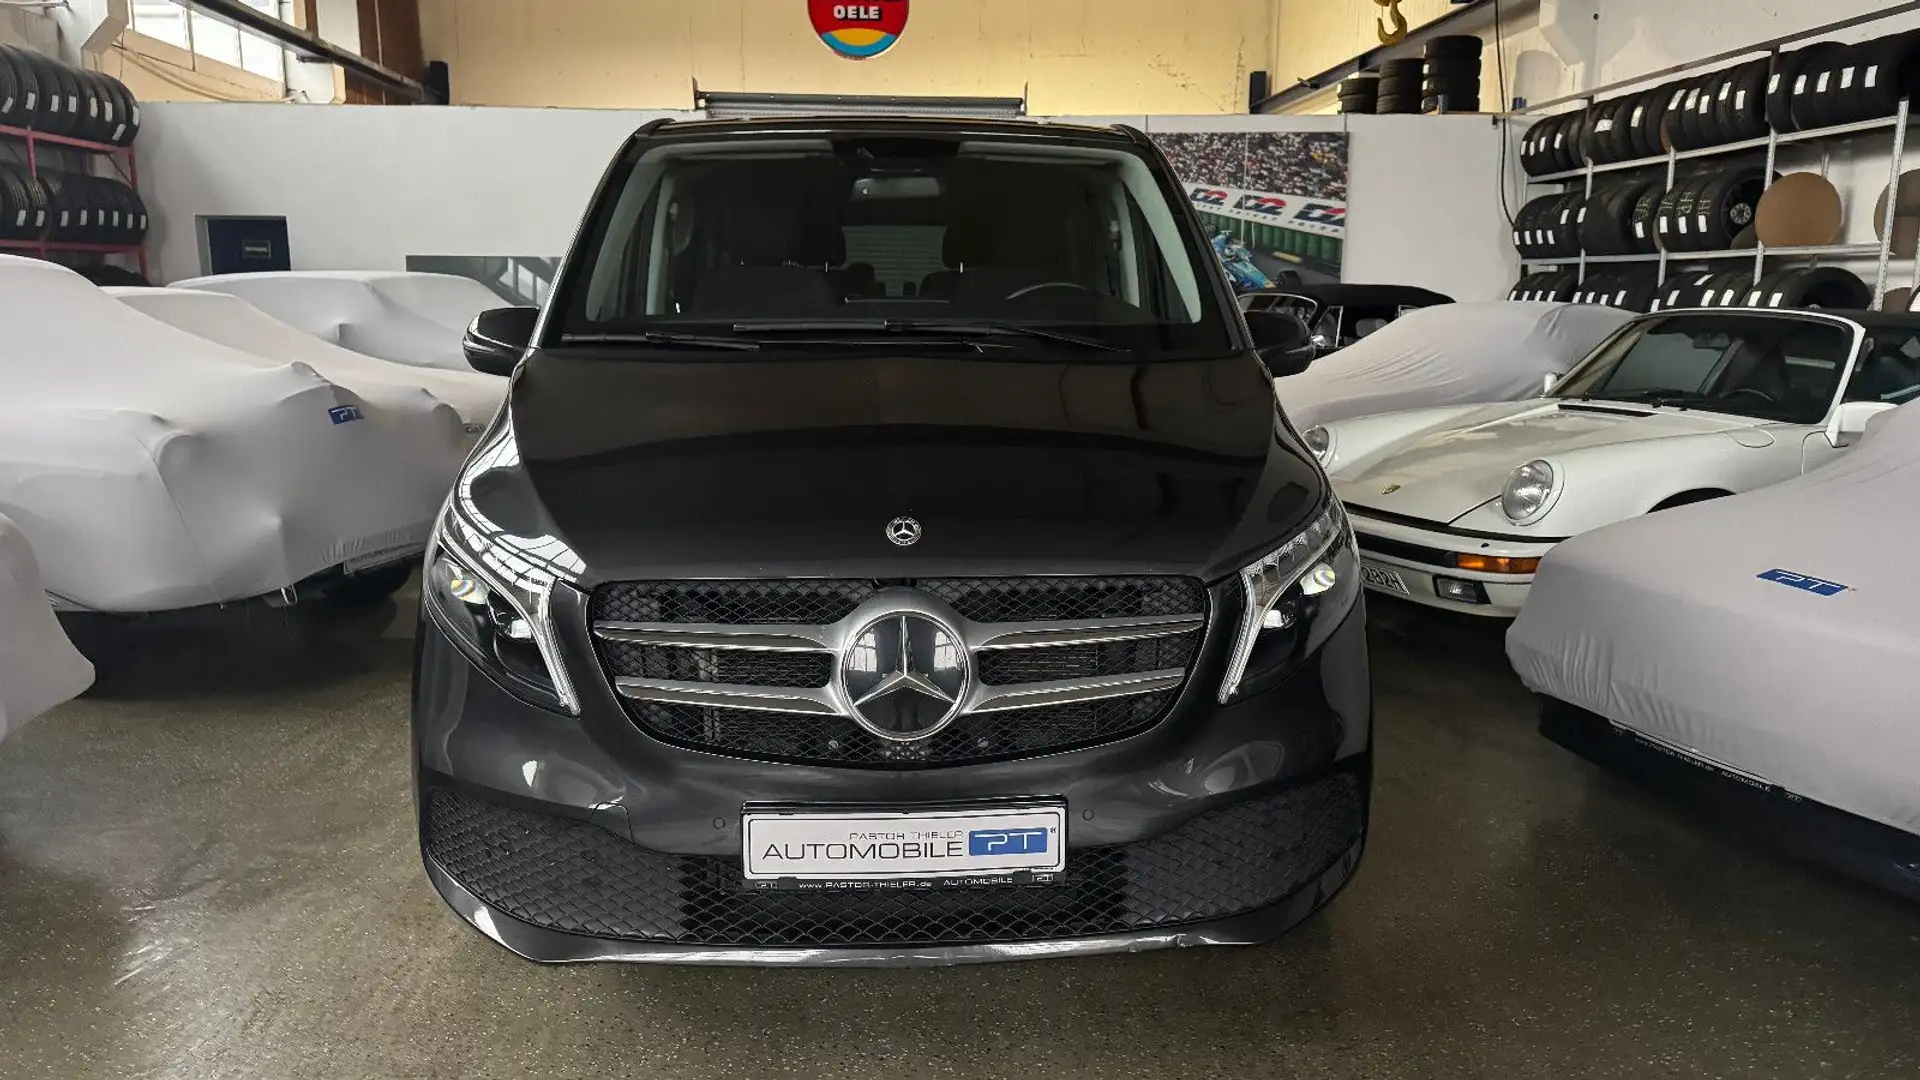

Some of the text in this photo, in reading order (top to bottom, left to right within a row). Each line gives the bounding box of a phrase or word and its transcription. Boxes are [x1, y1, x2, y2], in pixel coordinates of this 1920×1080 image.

[833, 5, 881, 20] OELE
[331, 406, 358, 421] PT
[1775, 570, 1841, 590] PT
[849, 830, 964, 840] PASTOR THIELER
[974, 831, 1043, 852] PT
[762, 841, 963, 860] AUTOMOBILE
[943, 877, 1013, 886] AUTOMOBILE
